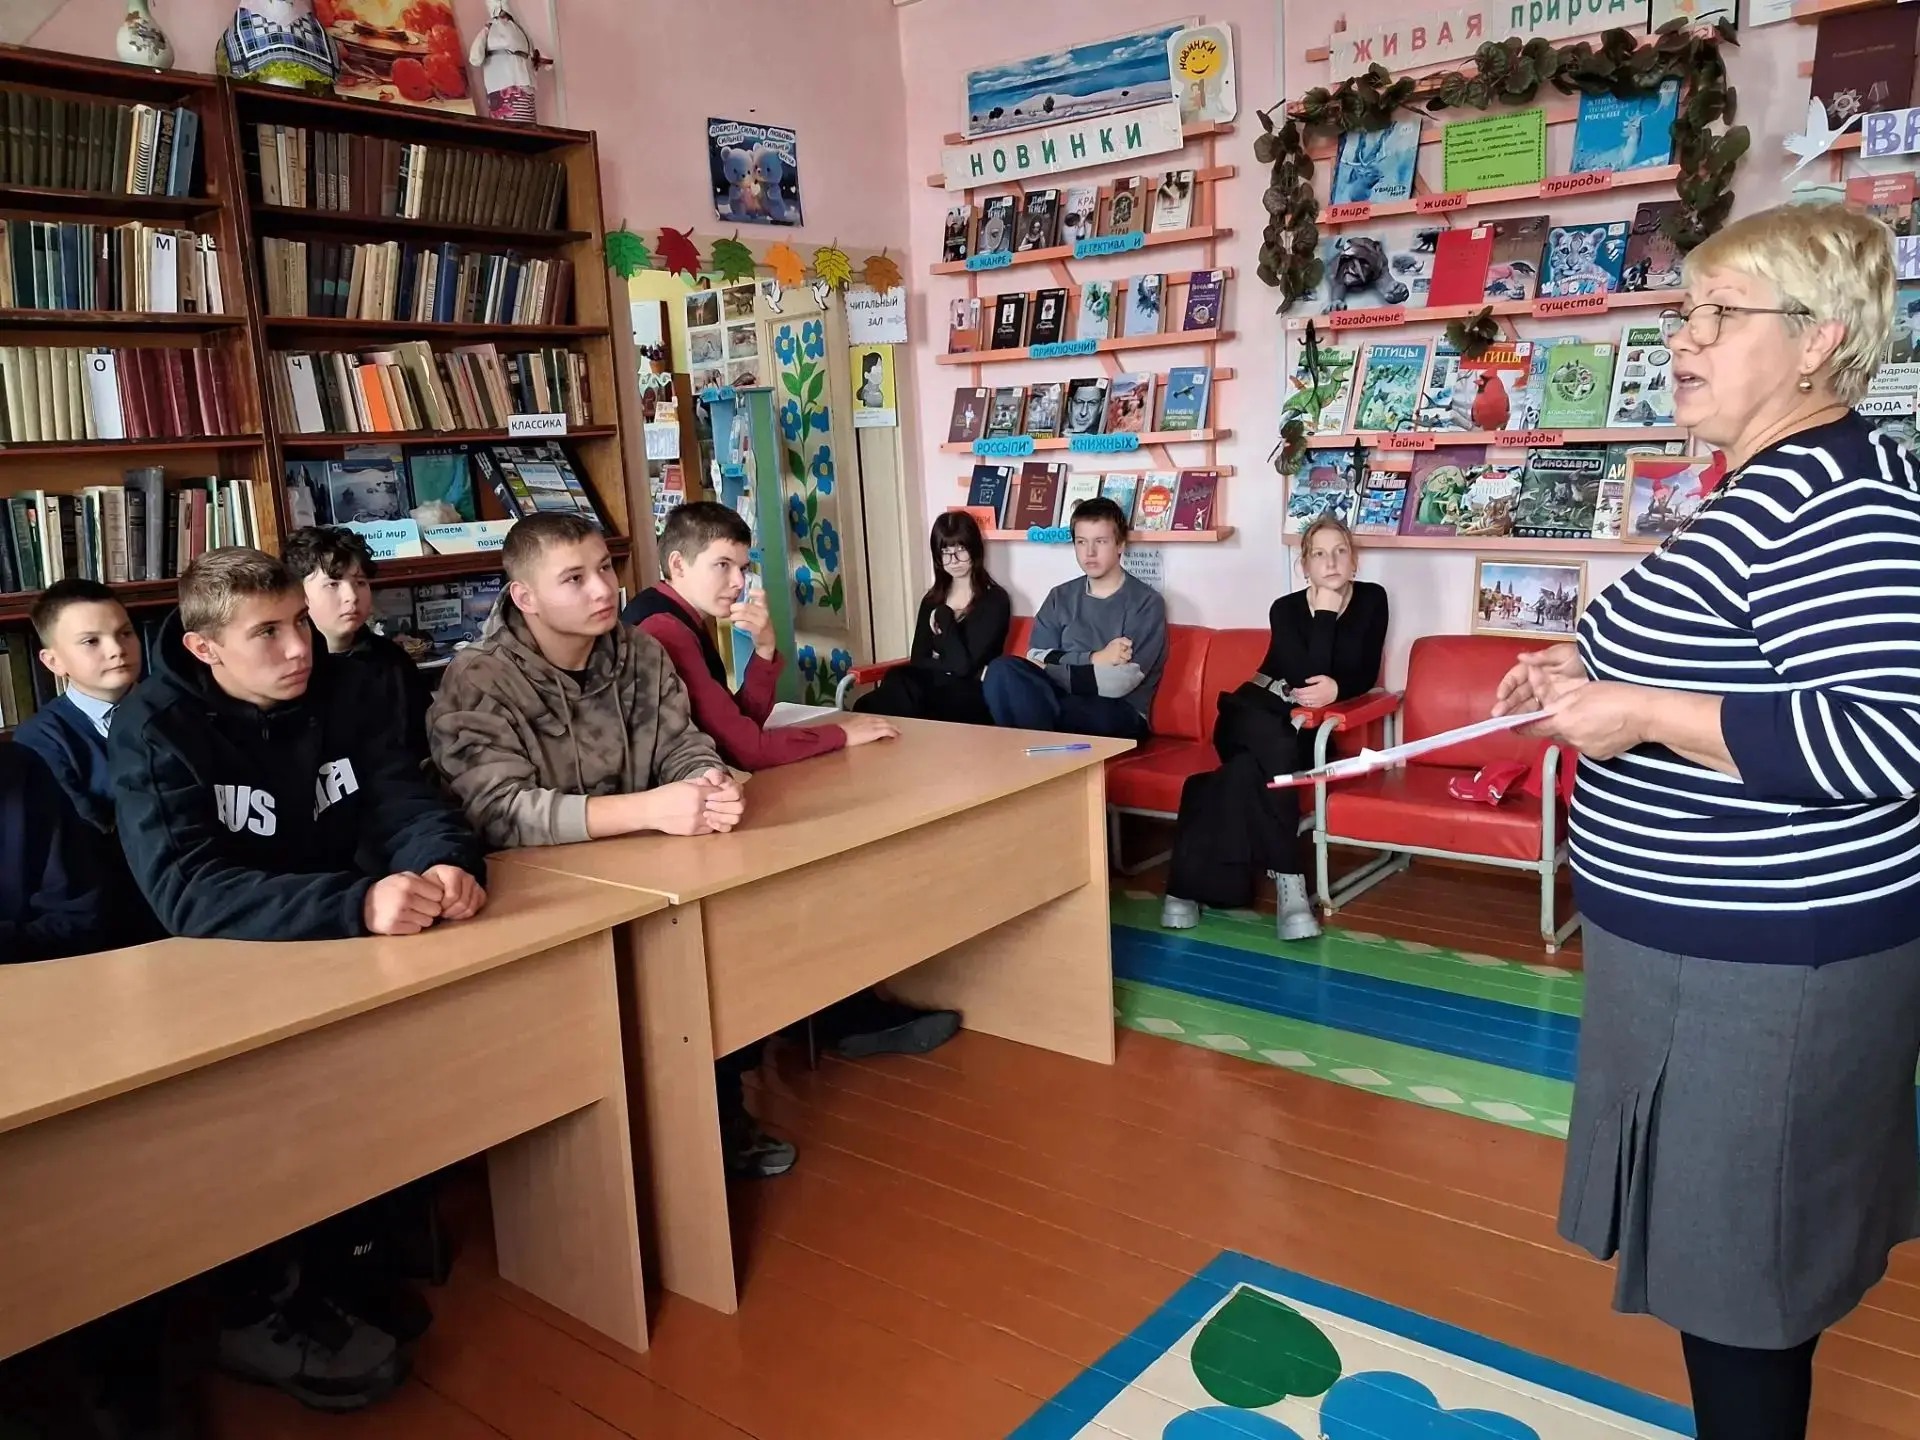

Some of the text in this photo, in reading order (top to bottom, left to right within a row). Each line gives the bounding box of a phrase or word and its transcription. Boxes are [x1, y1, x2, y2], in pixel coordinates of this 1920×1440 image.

[1353, 0, 1645, 63] ЖИВАЯ природ
[1179, 39, 1217, 70] НОВИНКИ
[970, 122, 1143, 177] НОВИНКИ
[1546, 174, 1605, 193] природы
[1423, 196, 1462, 209] живой
[1340, 205, 1369, 217] мире
[155, 236, 171, 250] М
[979, 256, 1008, 268] ЖАНРЕ
[850, 297, 898, 310] ЧИТАЛЬНЫЙ
[1539, 296, 1605, 313] существа
[867, 317, 883, 326] ЗАЛ
[1335, 312, 1401, 326] Загадочные
[1033, 340, 1097, 357] ПРИКЛЮЧЕНИЙ
[1880, 367, 1920, 376] ндрющ
[511, 417, 563, 431] КЛАССИКА
[1073, 436, 1134, 451] КНИЖНЫХ
[1390, 437, 1425, 449] Тайны
[1502, 433, 1557, 446] природы
[977, 441, 1027, 454] РОССЫПИ
[1533, 459, 1600, 469] ДИНОЗАВРЫ
[385, 529, 407, 543] мир
[424, 527, 463, 537] читаем
